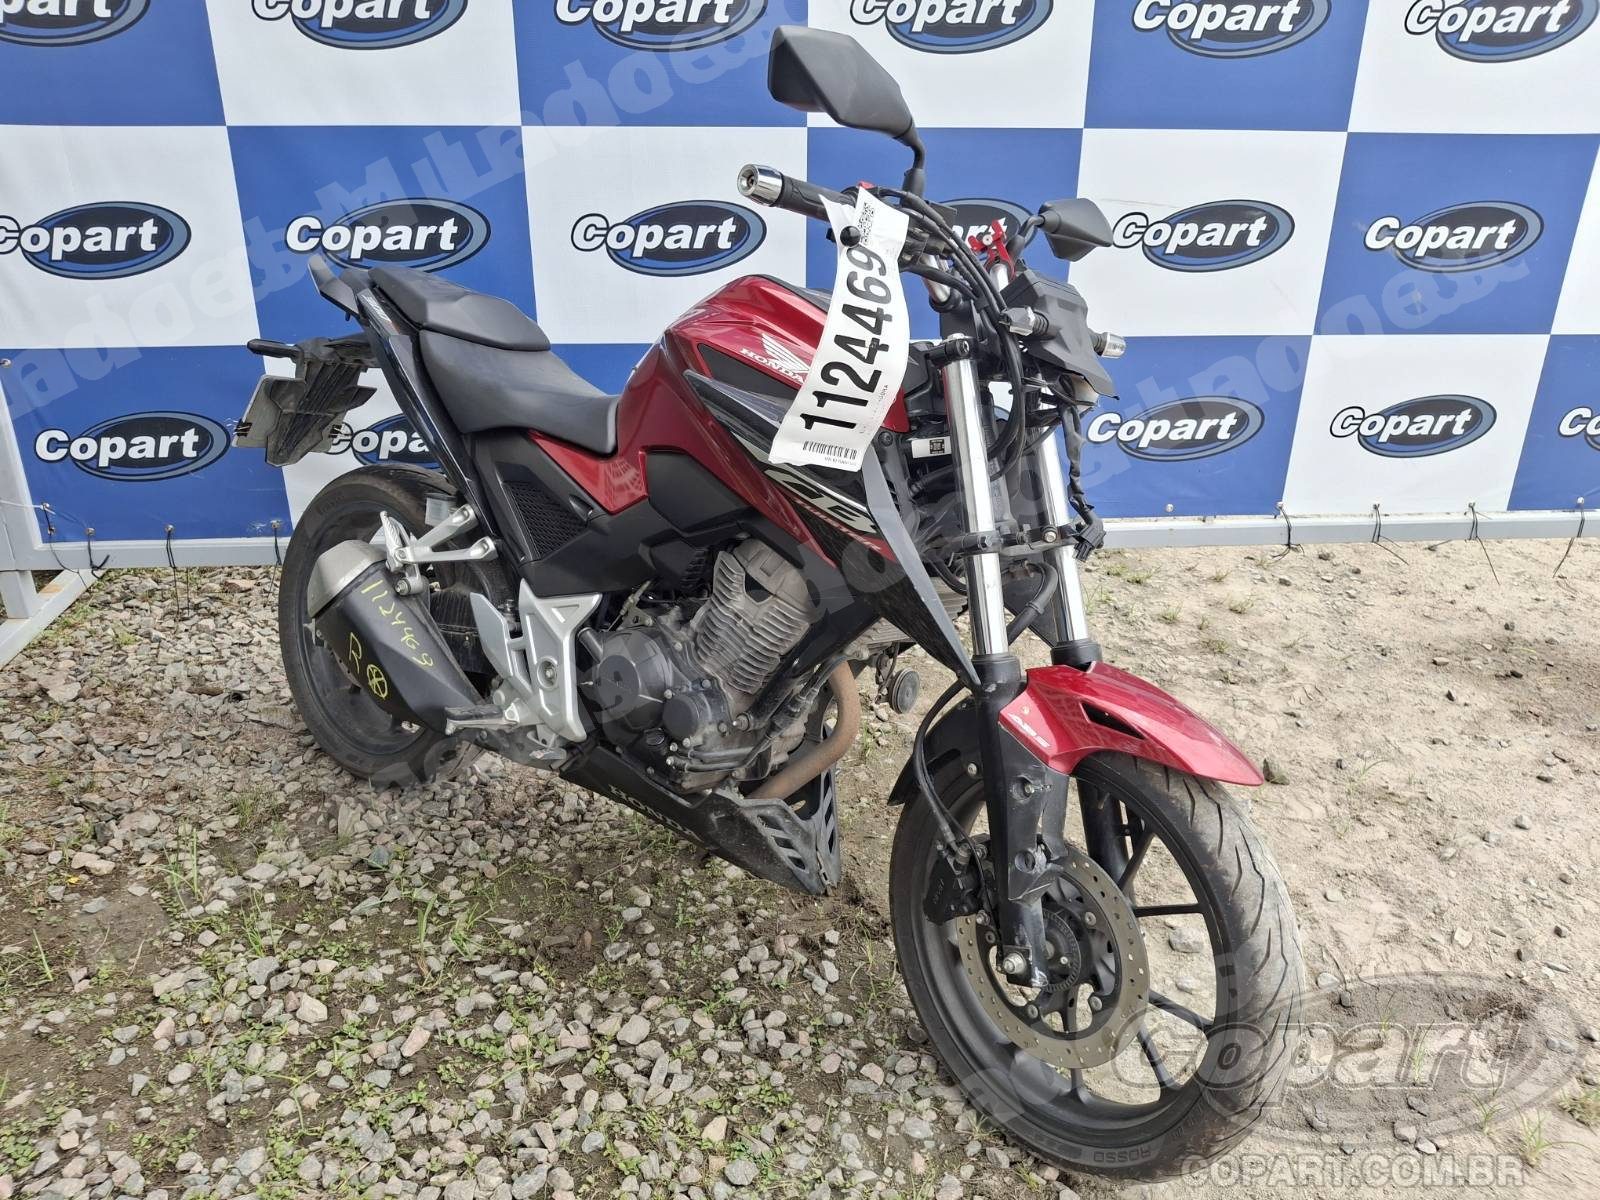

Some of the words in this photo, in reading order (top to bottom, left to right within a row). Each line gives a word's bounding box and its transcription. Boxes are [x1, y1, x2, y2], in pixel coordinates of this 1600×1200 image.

[555, 0, 732, 32] Copart
[850, 0, 1024, 33] Copart
[1132, 0, 1301, 39] Copart
[1405, 0, 1572, 43] Copart
[285, 216, 459, 260] Copart
[571, 213, 737, 258] Copart
[1112, 212, 1268, 255] Copart
[1364, 216, 1517, 257] Copart
[800, 246, 892, 431] 1124469
[1087, 411, 1238, 449] Copart
[1330, 406, 1472, 443] Copart
[35, 427, 199, 468] Copart
